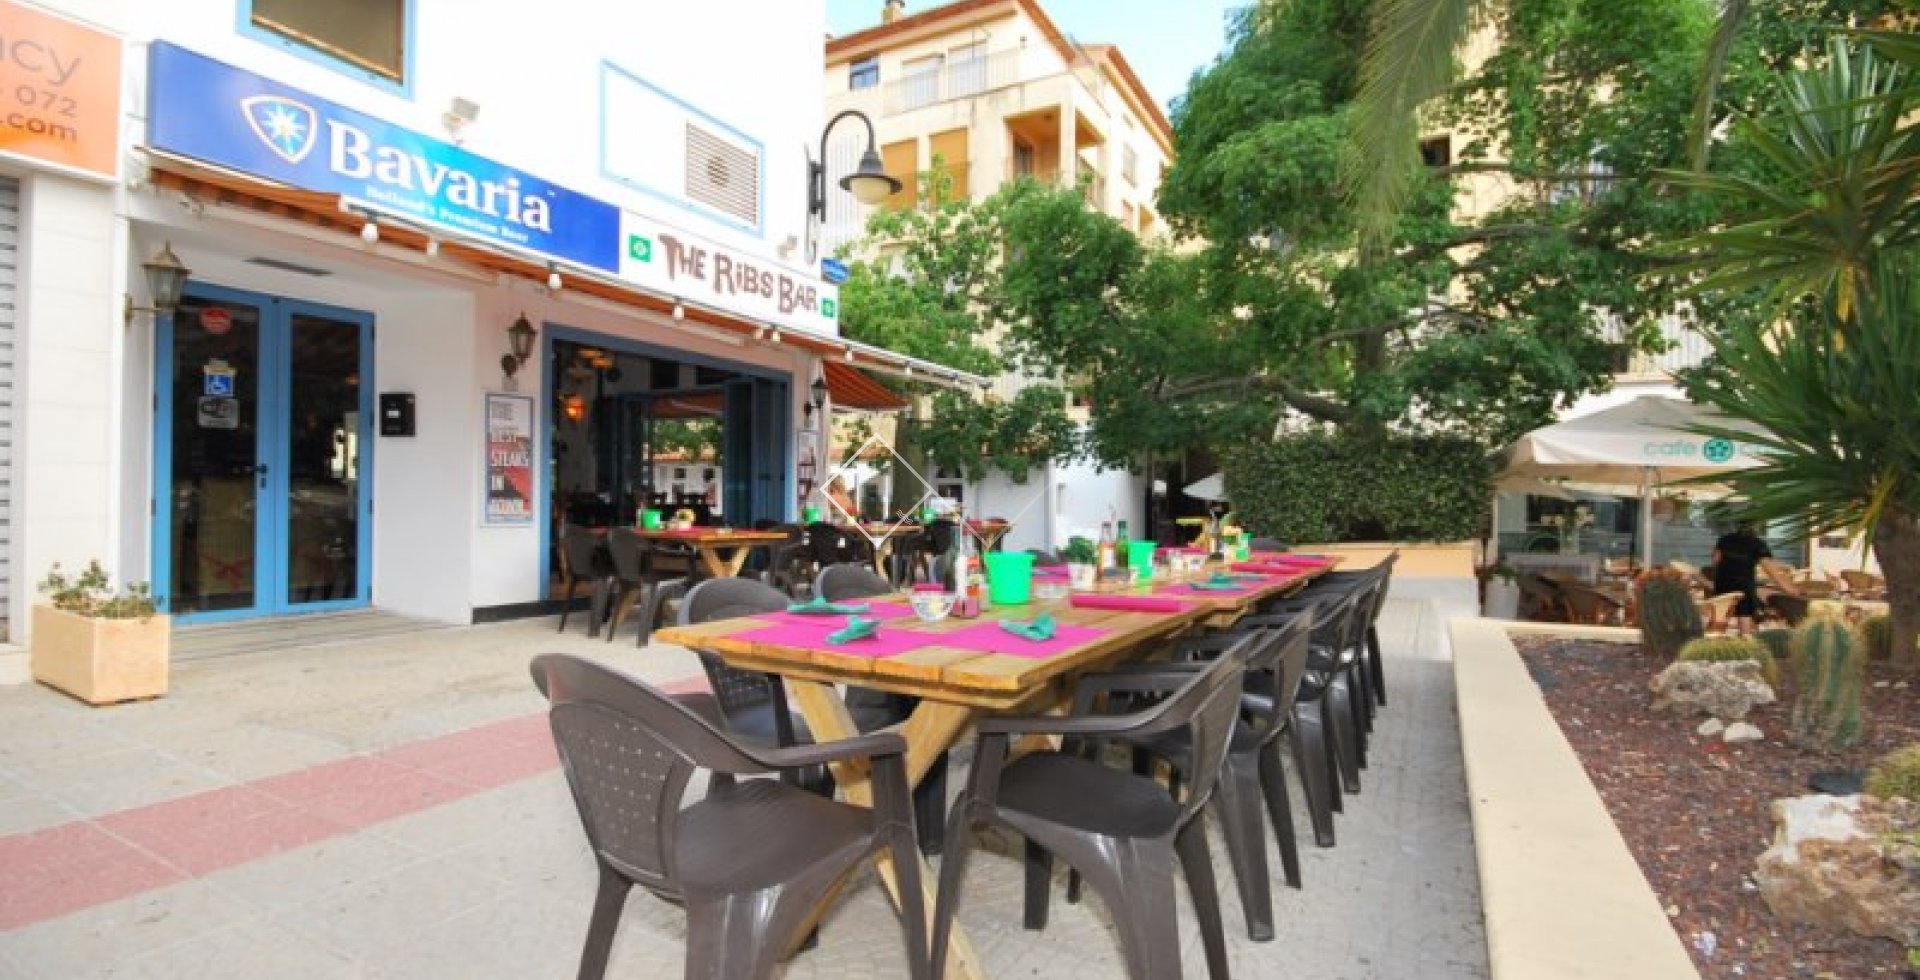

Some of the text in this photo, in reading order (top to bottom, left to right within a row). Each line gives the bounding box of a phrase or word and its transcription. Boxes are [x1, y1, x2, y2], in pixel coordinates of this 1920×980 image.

[0, 36, 81, 86] cy
[16, 85, 77, 116] 072
[326, 118, 551, 233] Bavaria
[658, 234, 707, 282] THE
[778, 274, 817, 314] BAR
